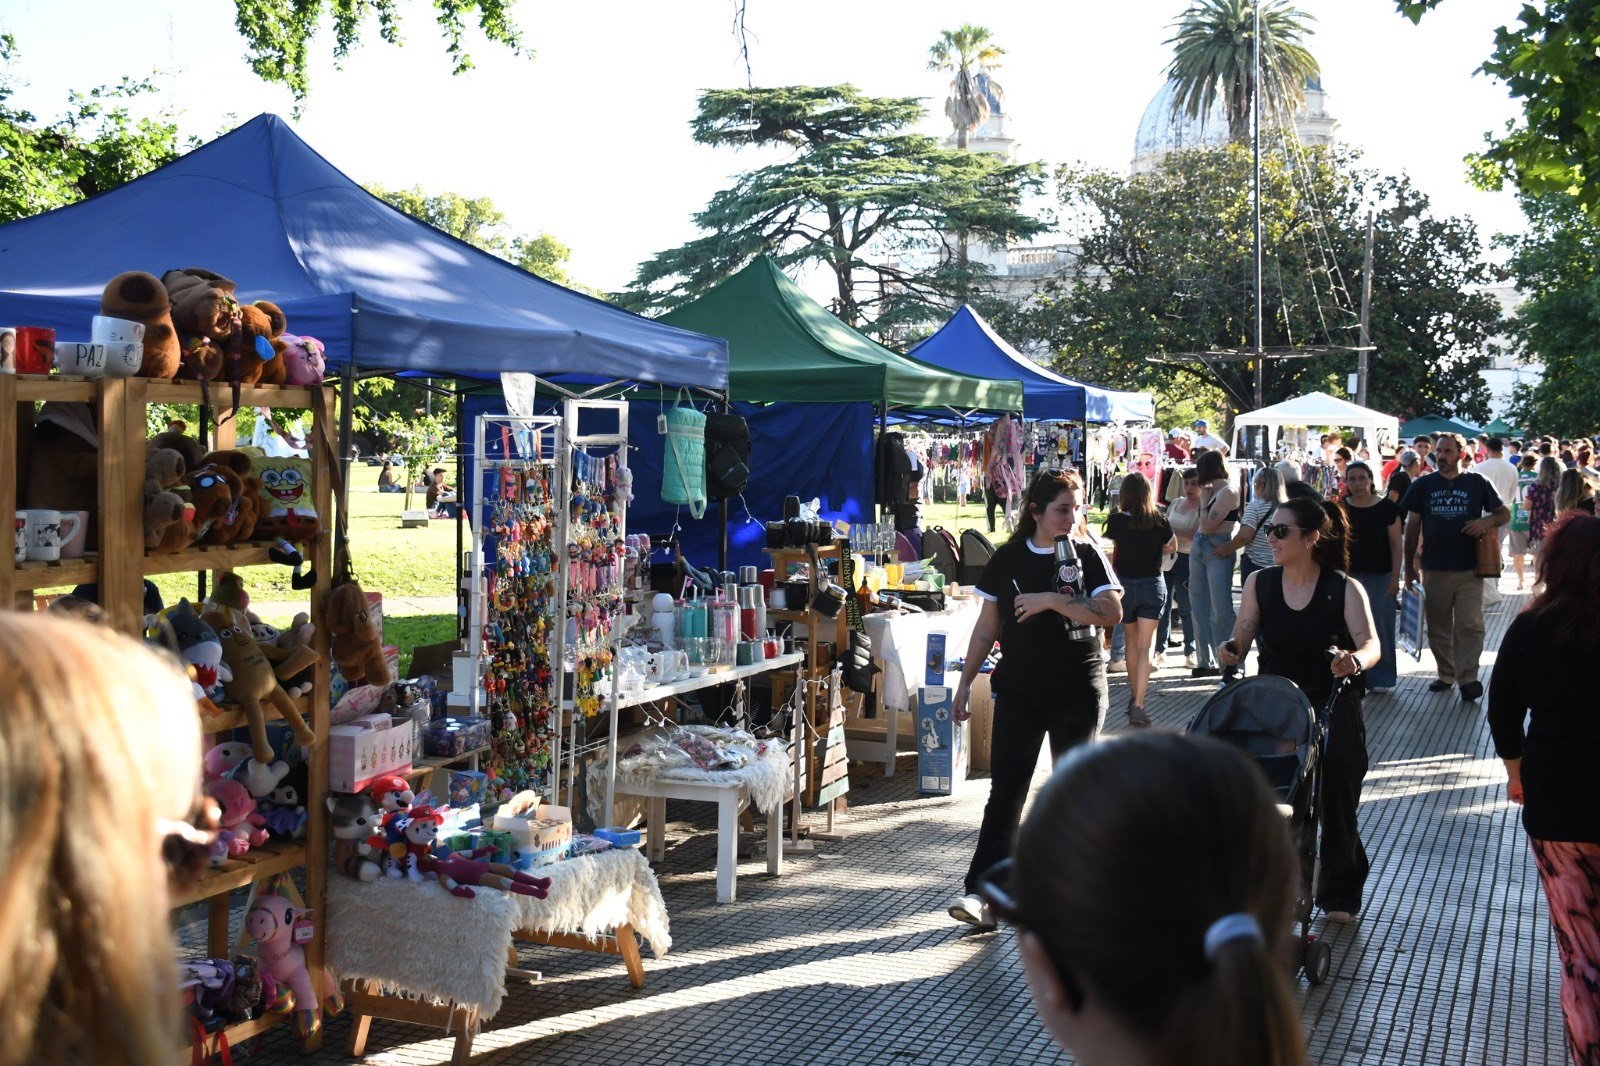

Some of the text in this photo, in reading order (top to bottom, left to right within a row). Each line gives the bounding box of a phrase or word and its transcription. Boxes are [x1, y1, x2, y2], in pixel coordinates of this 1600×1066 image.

[76, 343, 104, 368] PAZ
[1430, 489, 1468, 499] TAYLO MADE
[842, 547, 852, 589] WARNING
[846, 600, 854, 626] RNING
